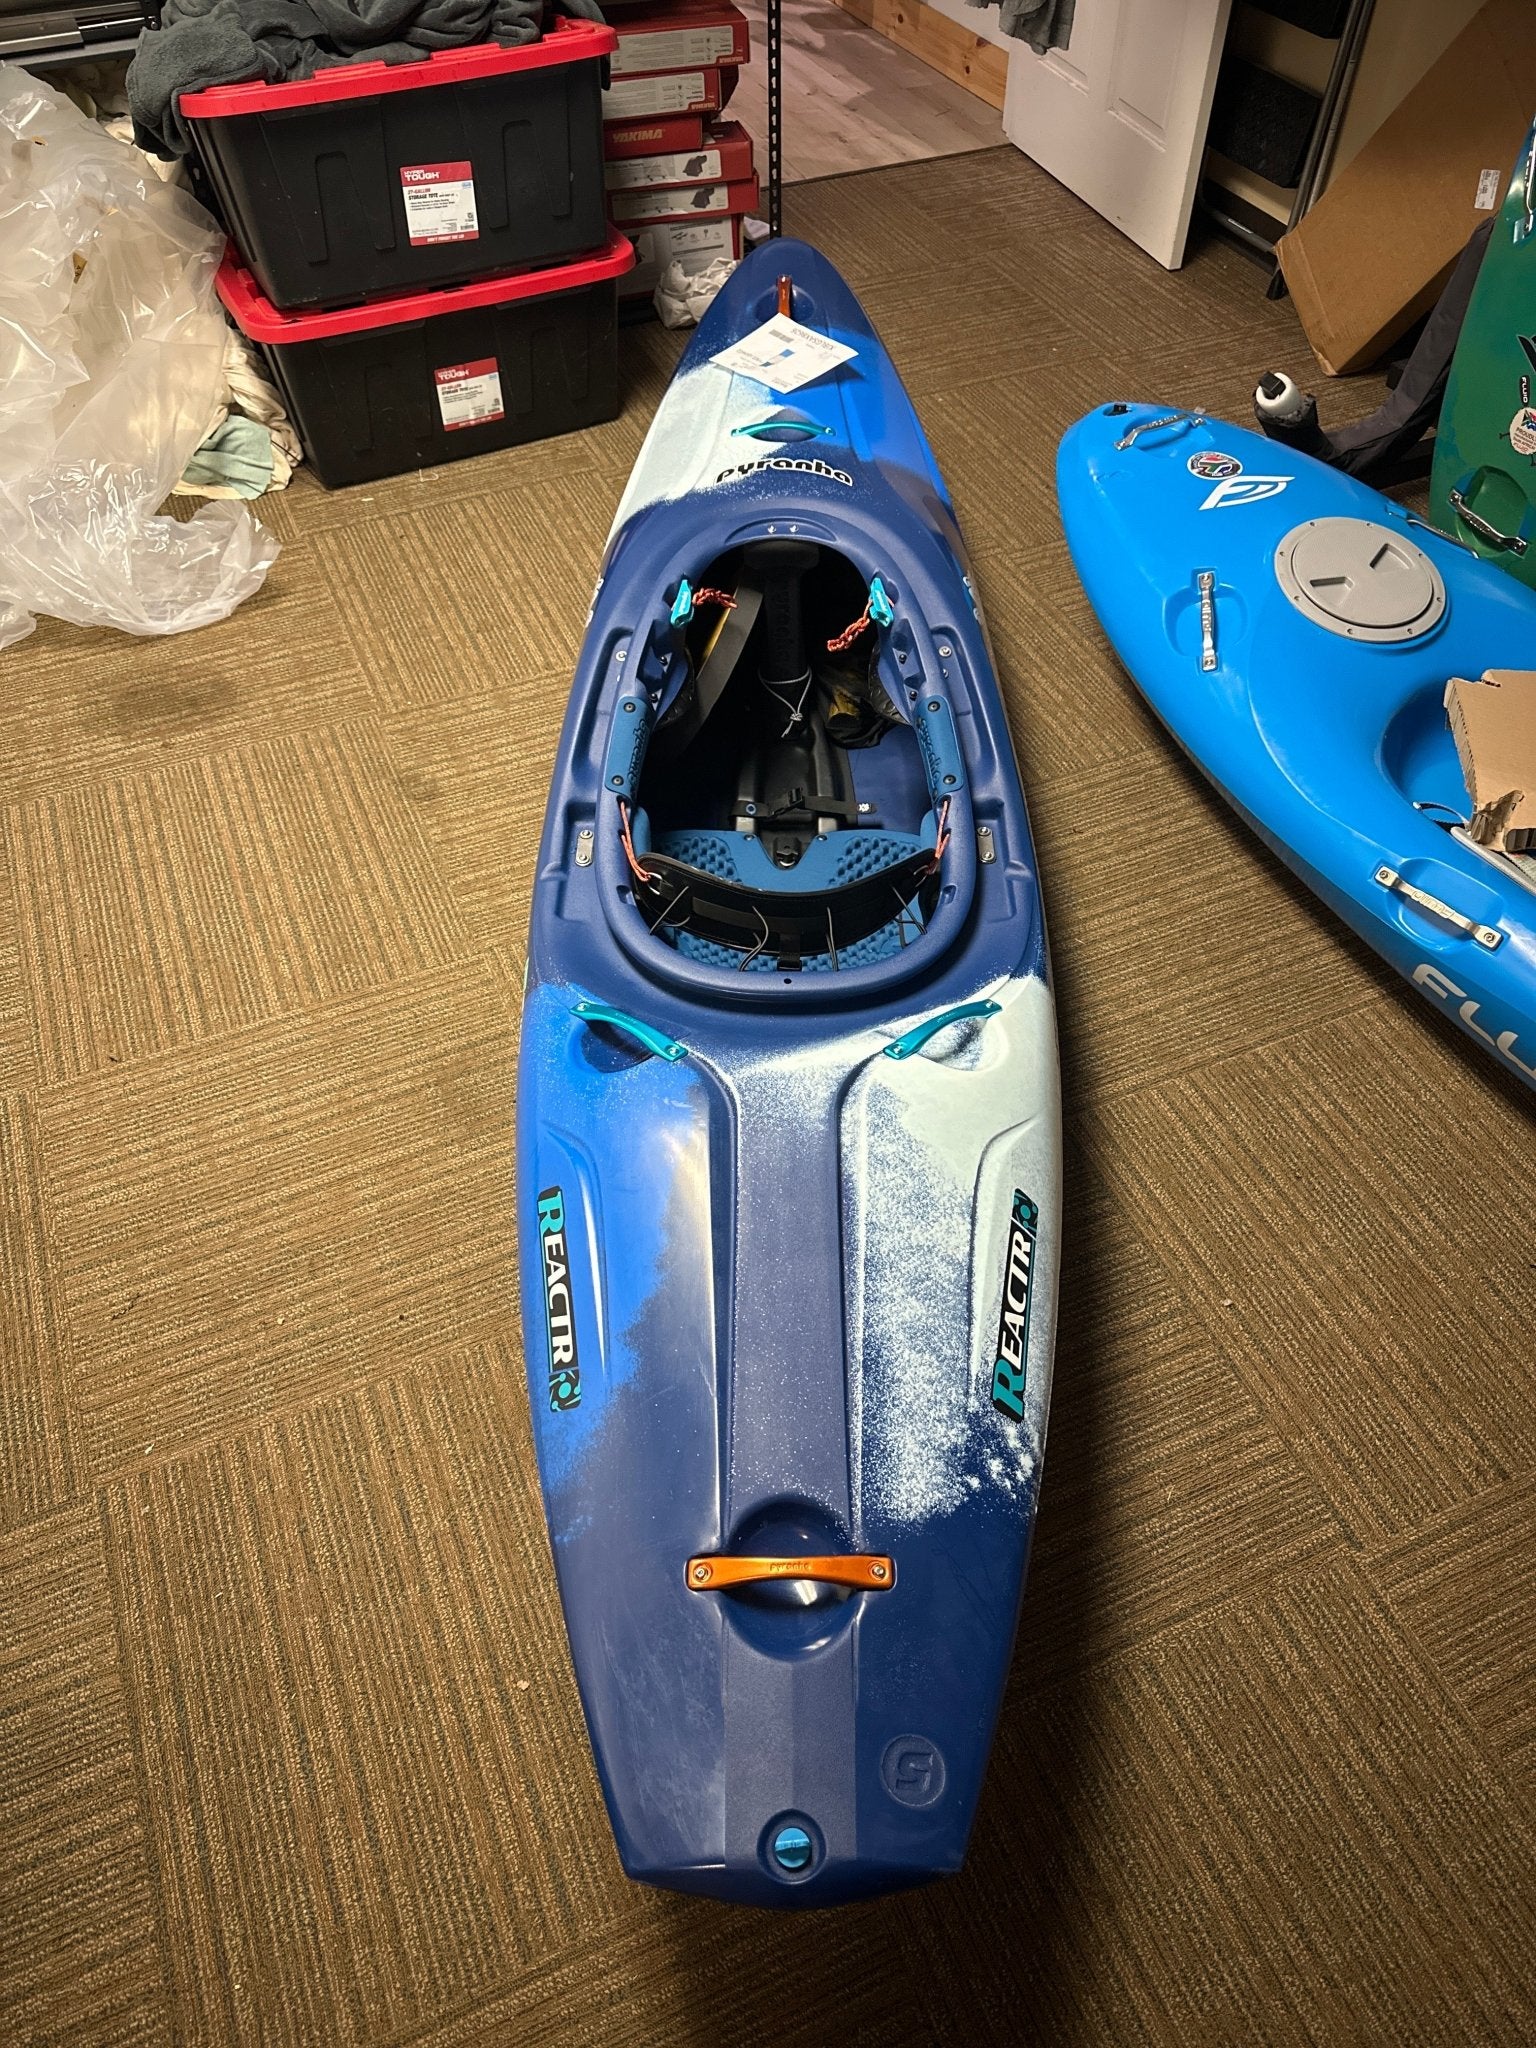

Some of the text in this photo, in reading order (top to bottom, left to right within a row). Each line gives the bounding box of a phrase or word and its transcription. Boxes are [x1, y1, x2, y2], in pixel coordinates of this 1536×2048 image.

[612, 129, 664, 143] YAKIMA
[405, 172, 440, 181] TOUGH
[439, 370, 469, 380] TOUGH
[715, 458, 853, 486] pyranha
